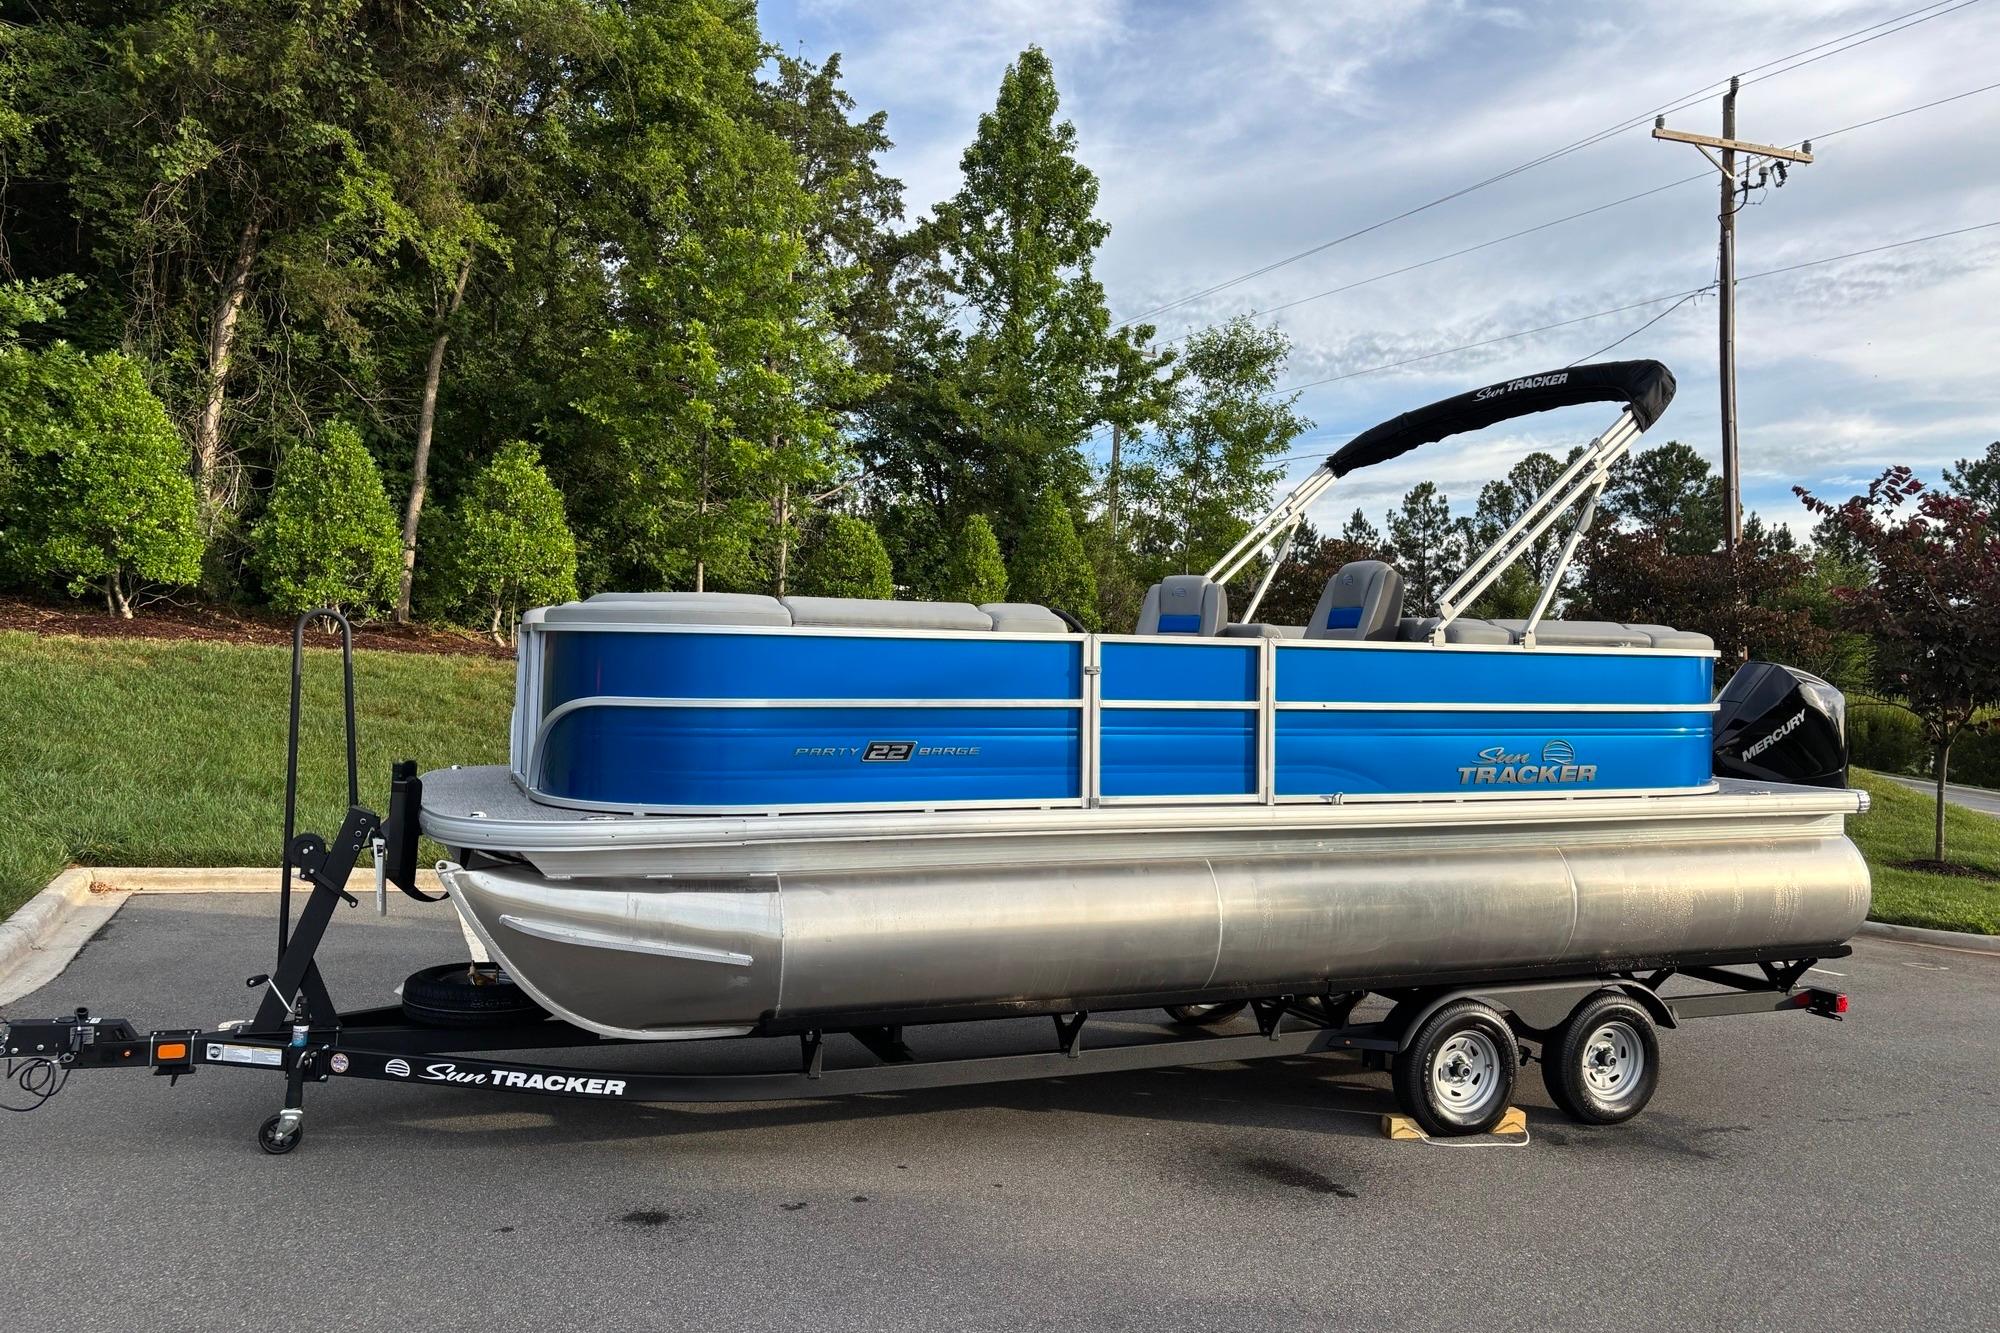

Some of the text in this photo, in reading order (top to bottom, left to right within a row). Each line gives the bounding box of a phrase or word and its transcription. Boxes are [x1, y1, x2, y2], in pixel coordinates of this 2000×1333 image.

[1471, 372, 1569, 402] Sun TRACKER
[1741, 708, 1806, 763] MERCURY
[794, 744, 982, 761] PARTY 22 BARGE
[1471, 746, 1530, 765] Sun
[1457, 765, 1598, 786] TRACKER
[417, 1063, 628, 1096] Sun TRACKER
